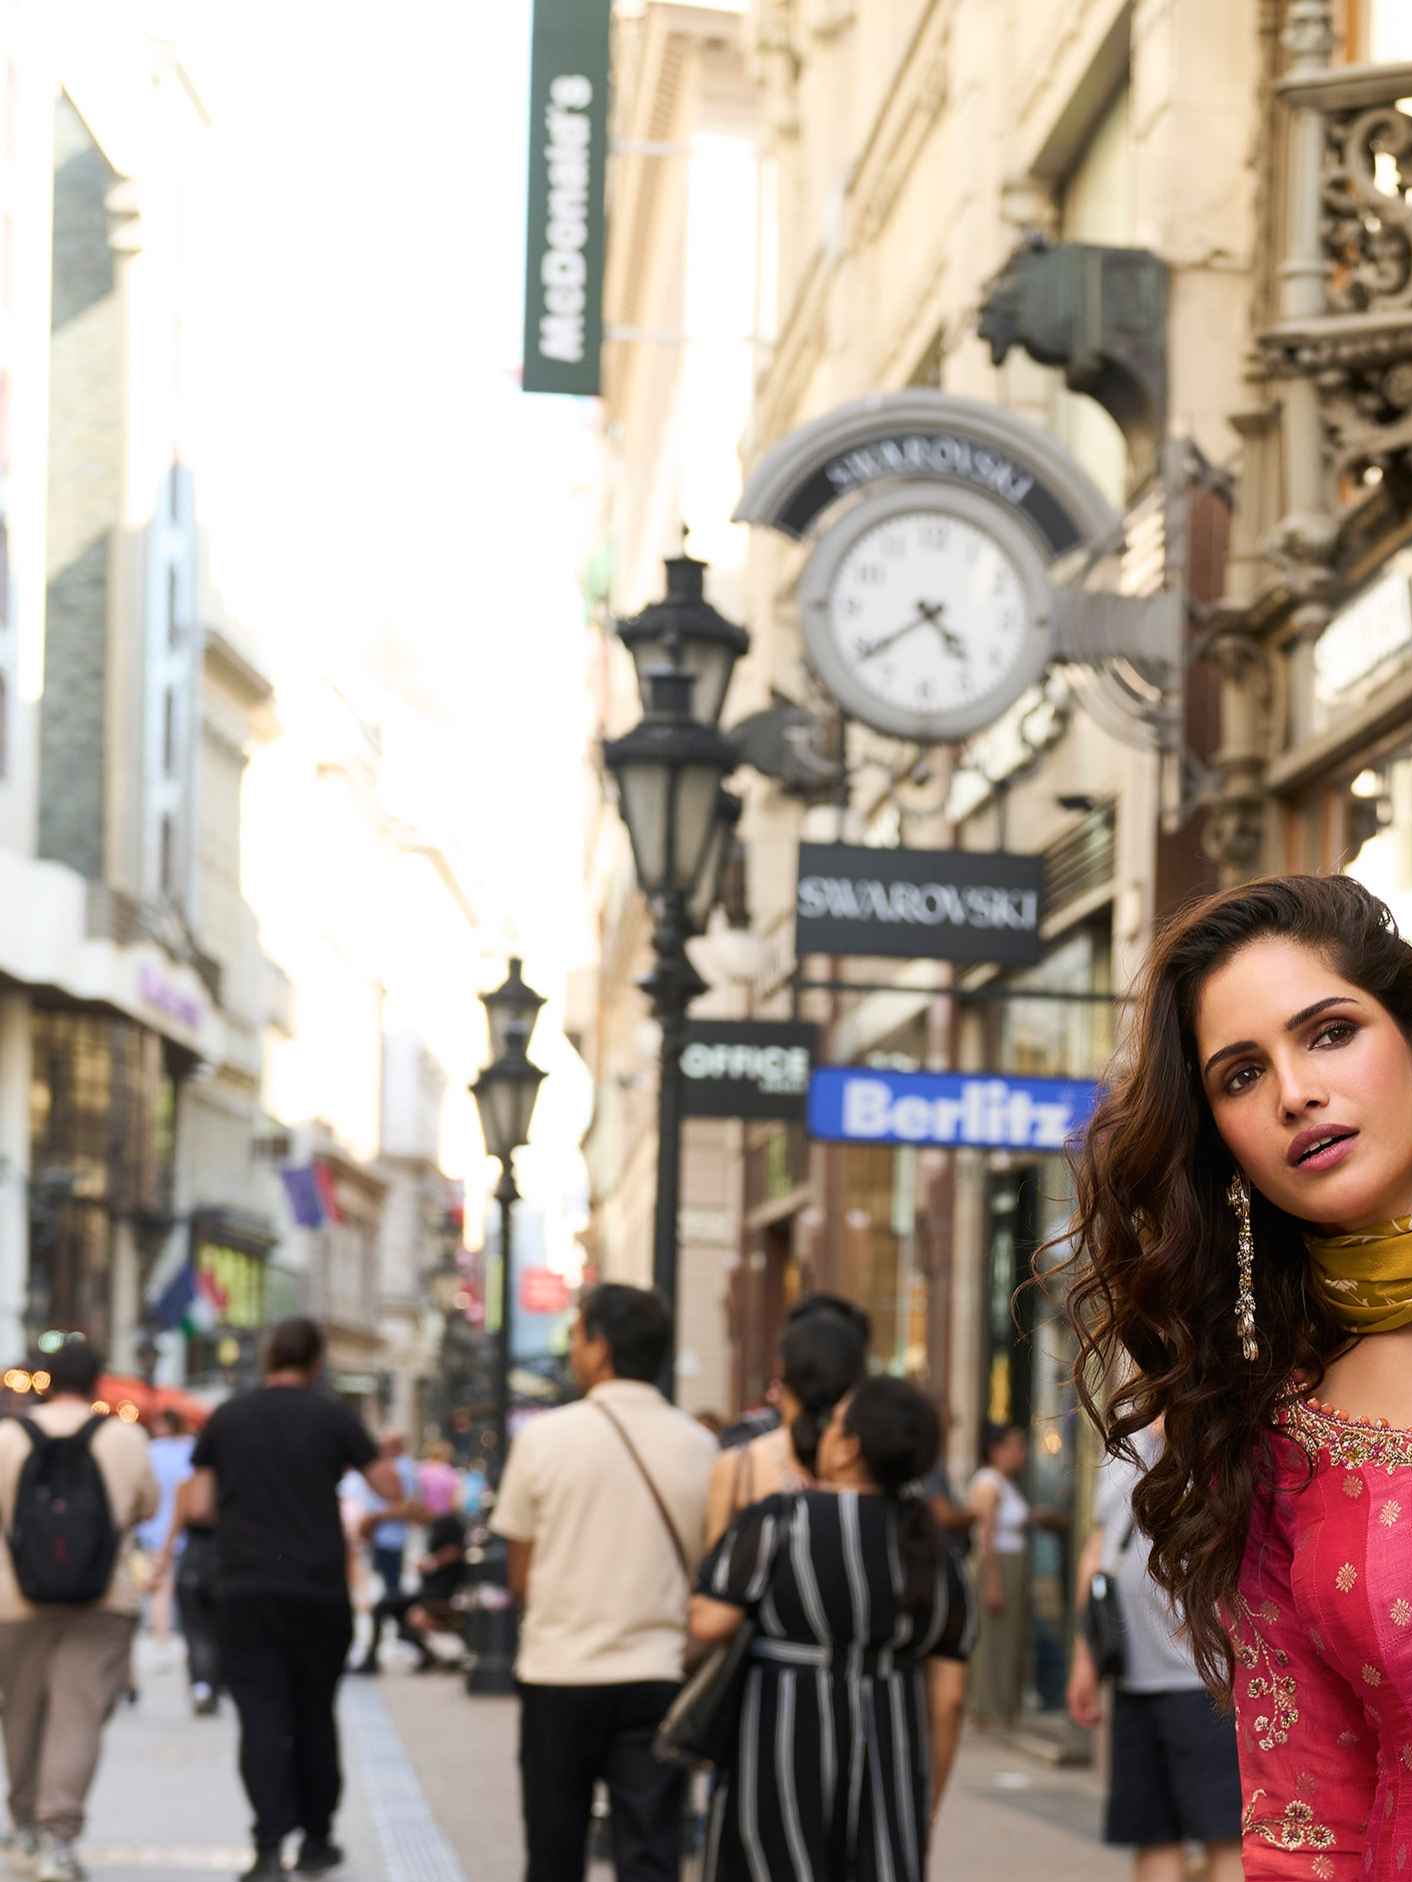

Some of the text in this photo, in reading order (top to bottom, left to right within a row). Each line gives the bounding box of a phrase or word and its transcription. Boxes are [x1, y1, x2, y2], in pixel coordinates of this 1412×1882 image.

[799, 877, 1038, 930] SWAROVSKI
[680, 1044, 810, 1080] OFFICE
[842, 1078, 1077, 1147] Berlitz
